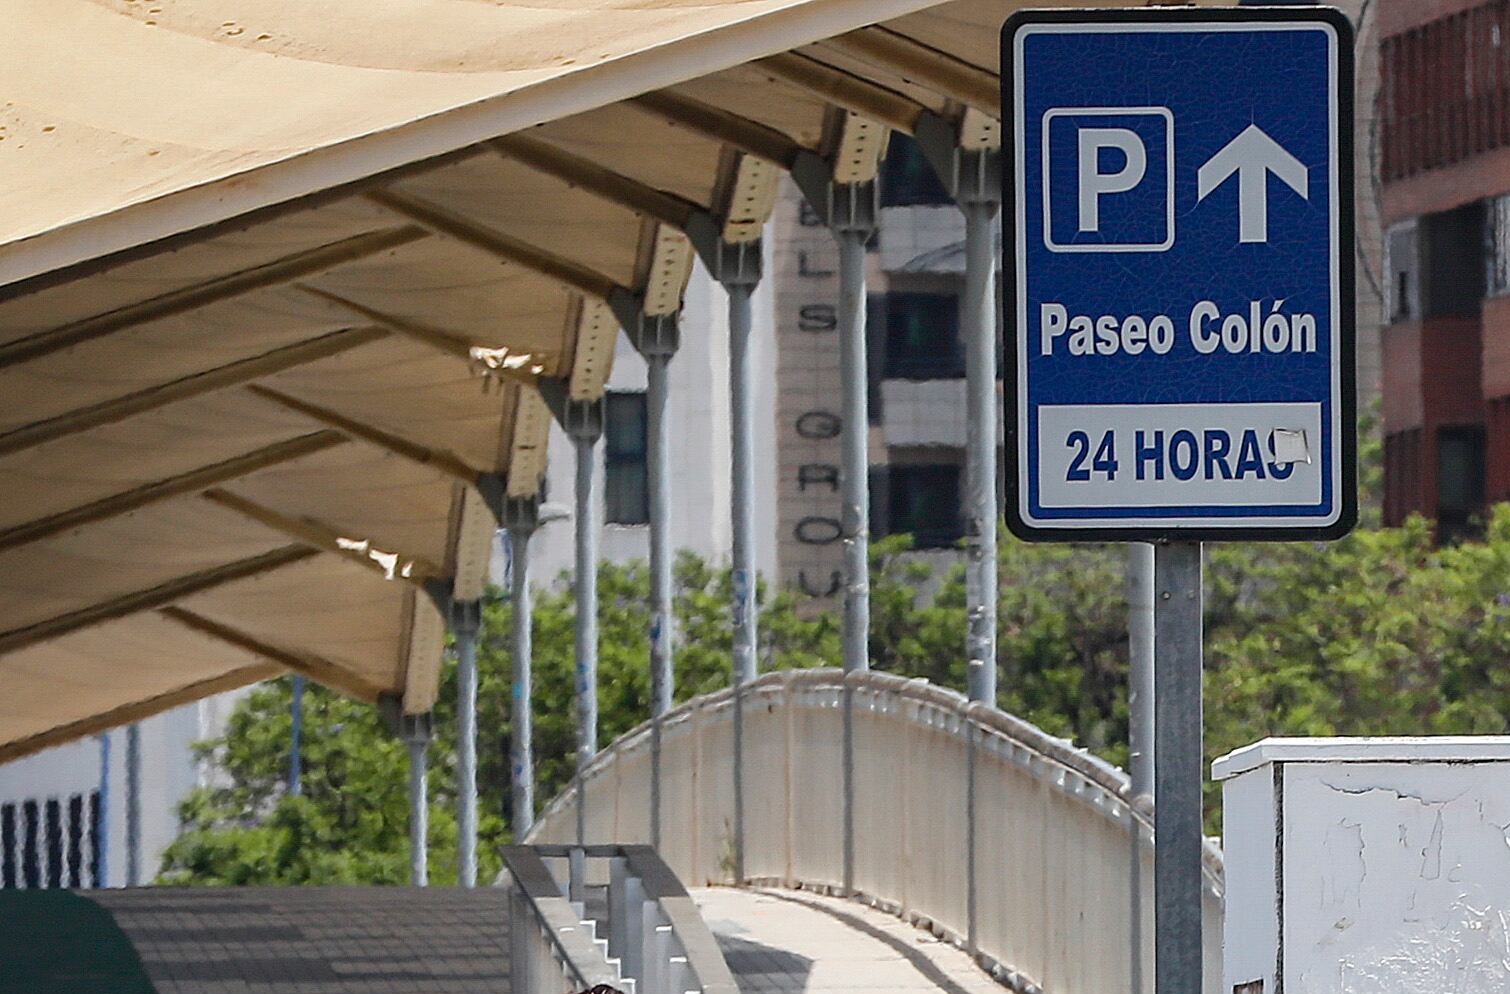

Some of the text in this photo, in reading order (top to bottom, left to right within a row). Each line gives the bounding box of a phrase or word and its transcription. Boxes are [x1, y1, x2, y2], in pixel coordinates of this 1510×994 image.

[1078, 127, 1147, 232] P
[1040, 299, 1317, 355] Paseo Colón
[1065, 429, 1119, 482] 24
